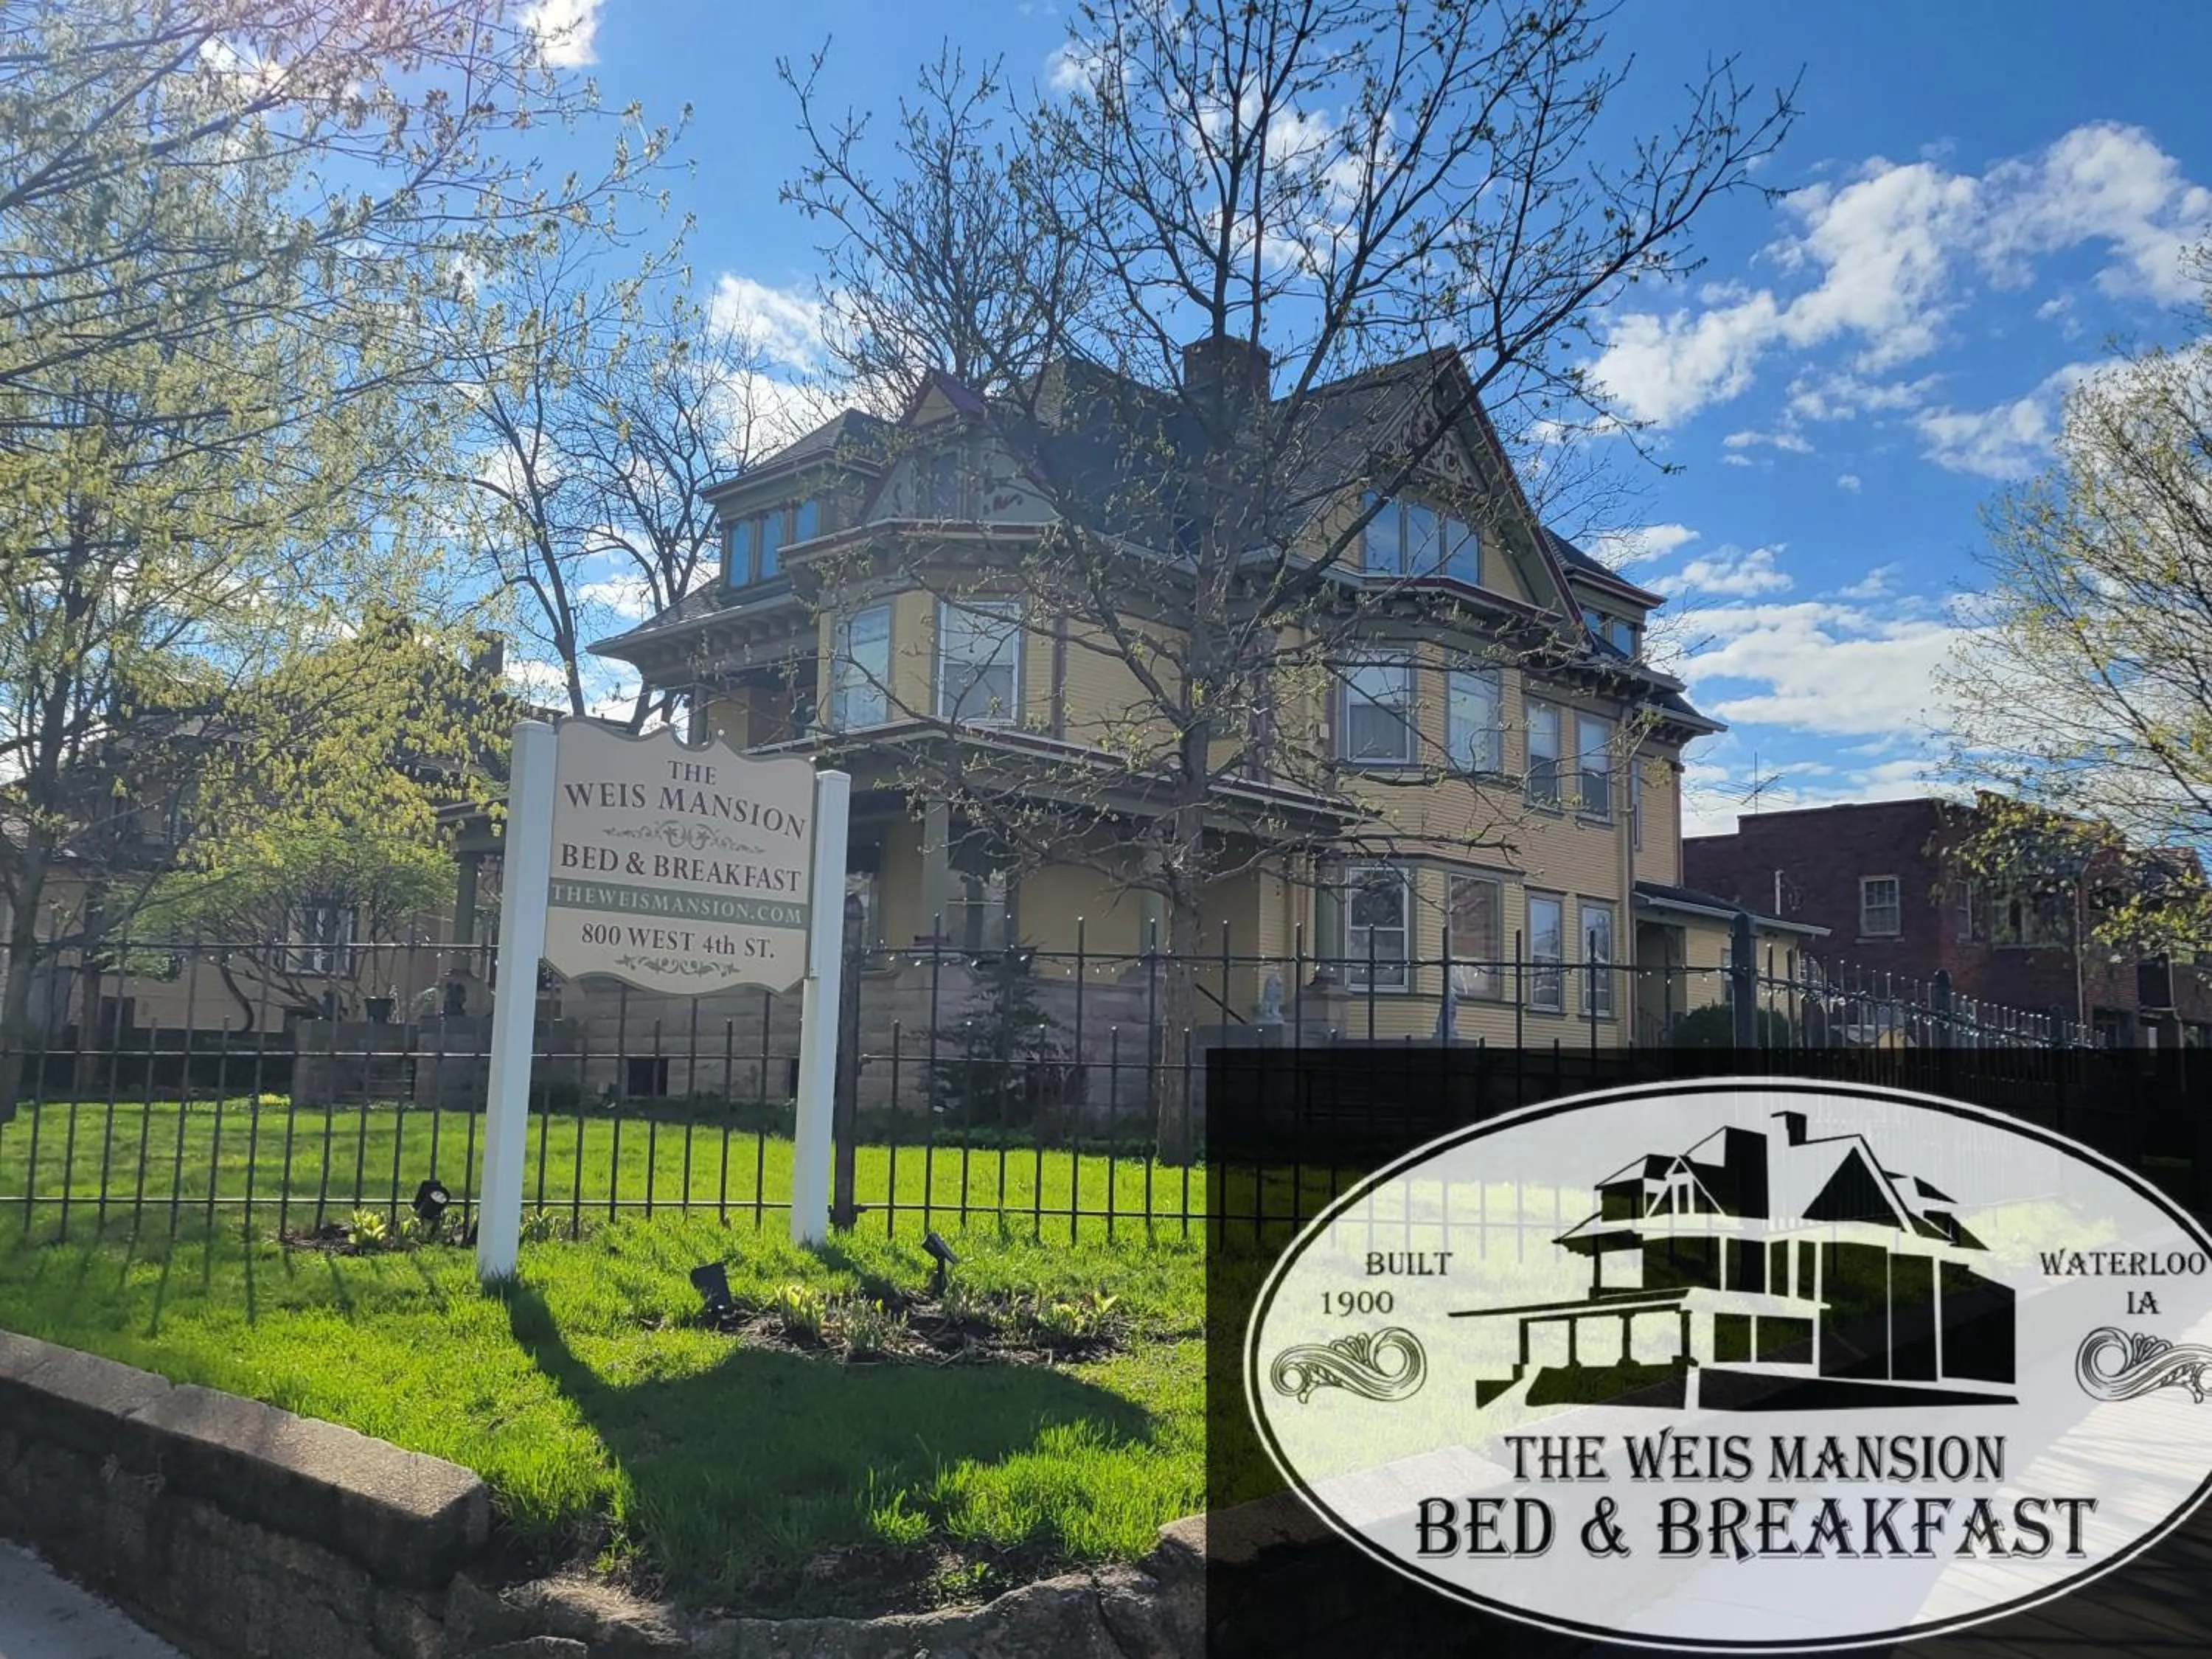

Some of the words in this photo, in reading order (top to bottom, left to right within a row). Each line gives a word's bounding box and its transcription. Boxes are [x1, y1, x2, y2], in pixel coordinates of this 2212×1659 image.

[667, 760, 717, 785] THE
[565, 783, 646, 808] WEIS
[659, 788, 806, 841] MANSION
[560, 844, 619, 872] BED
[625, 852, 645, 875] &
[654, 855, 801, 891] BREAKFAST
[552, 885, 802, 925] THEWEISMANSION.COM
[581, 923, 622, 946] 800
[627, 928, 695, 953] WEST
[703, 936, 736, 956] 4th
[744, 939, 774, 959] ST.
